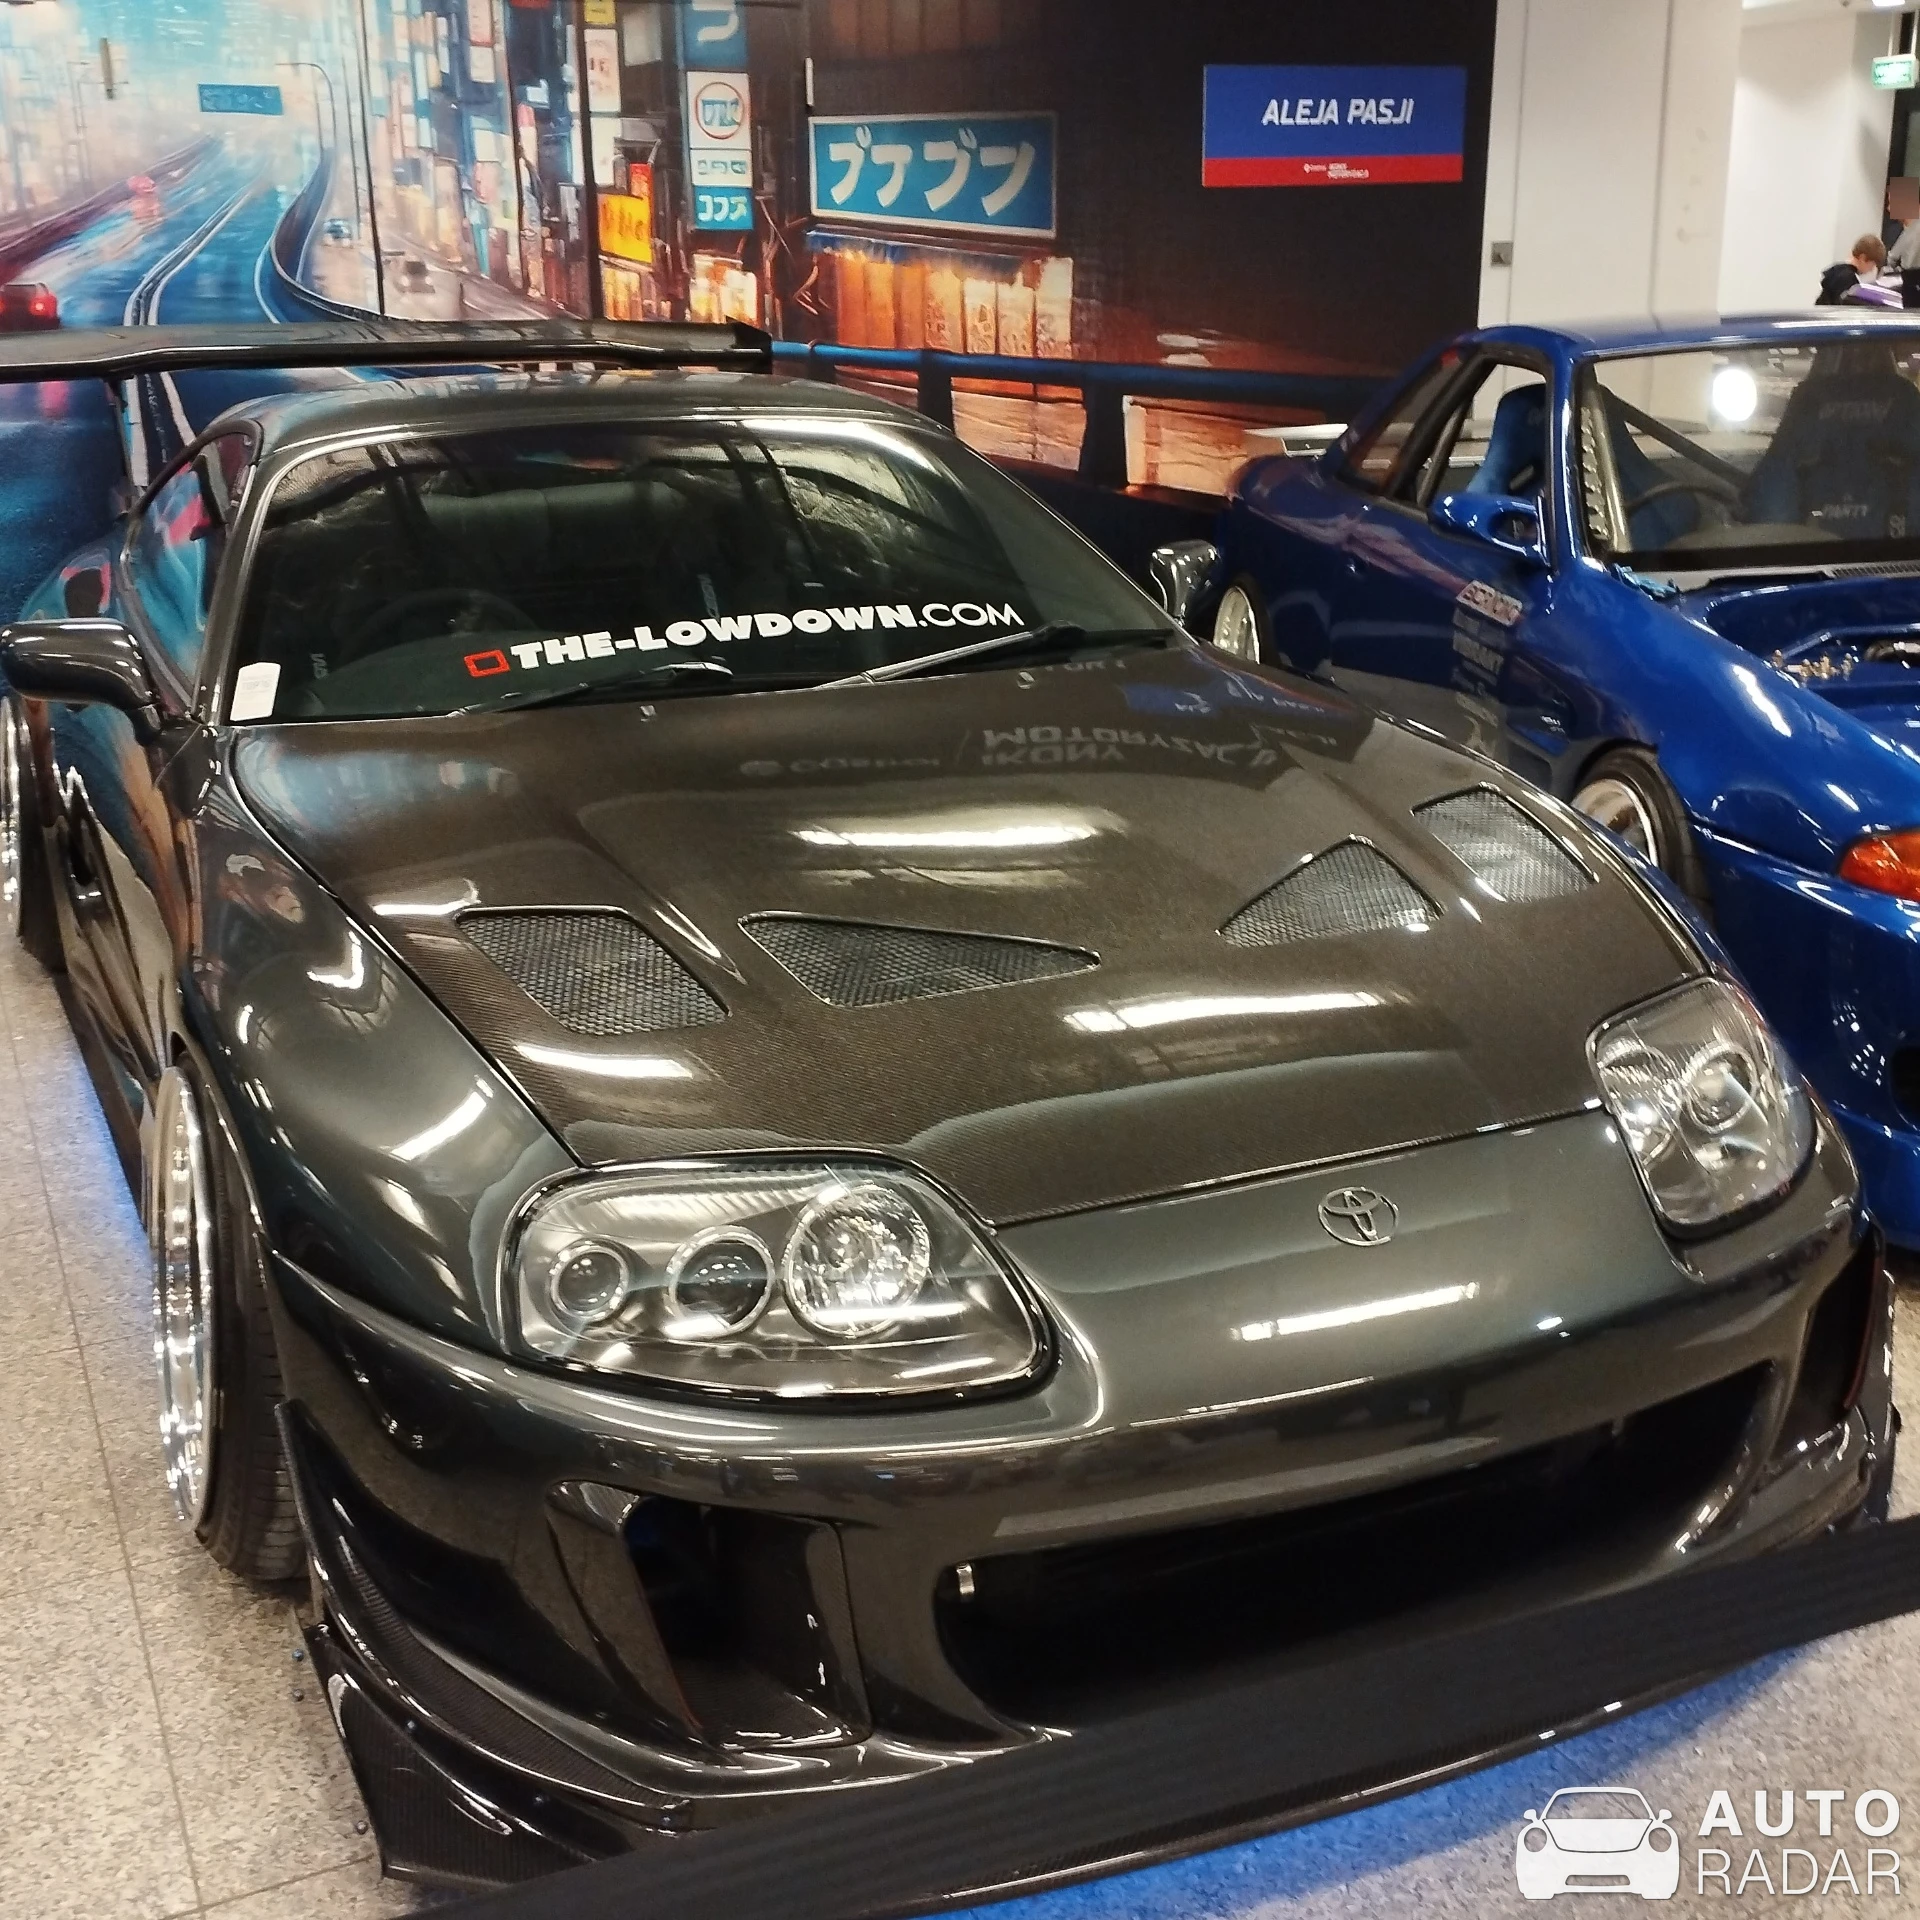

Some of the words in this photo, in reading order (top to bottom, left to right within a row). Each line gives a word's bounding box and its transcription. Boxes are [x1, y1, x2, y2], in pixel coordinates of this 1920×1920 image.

[1261, 98, 1340, 126] ALEJA
[1347, 98, 1415, 125] PASJI
[510, 602, 1025, 670] THE-LOWDOWN.COM
